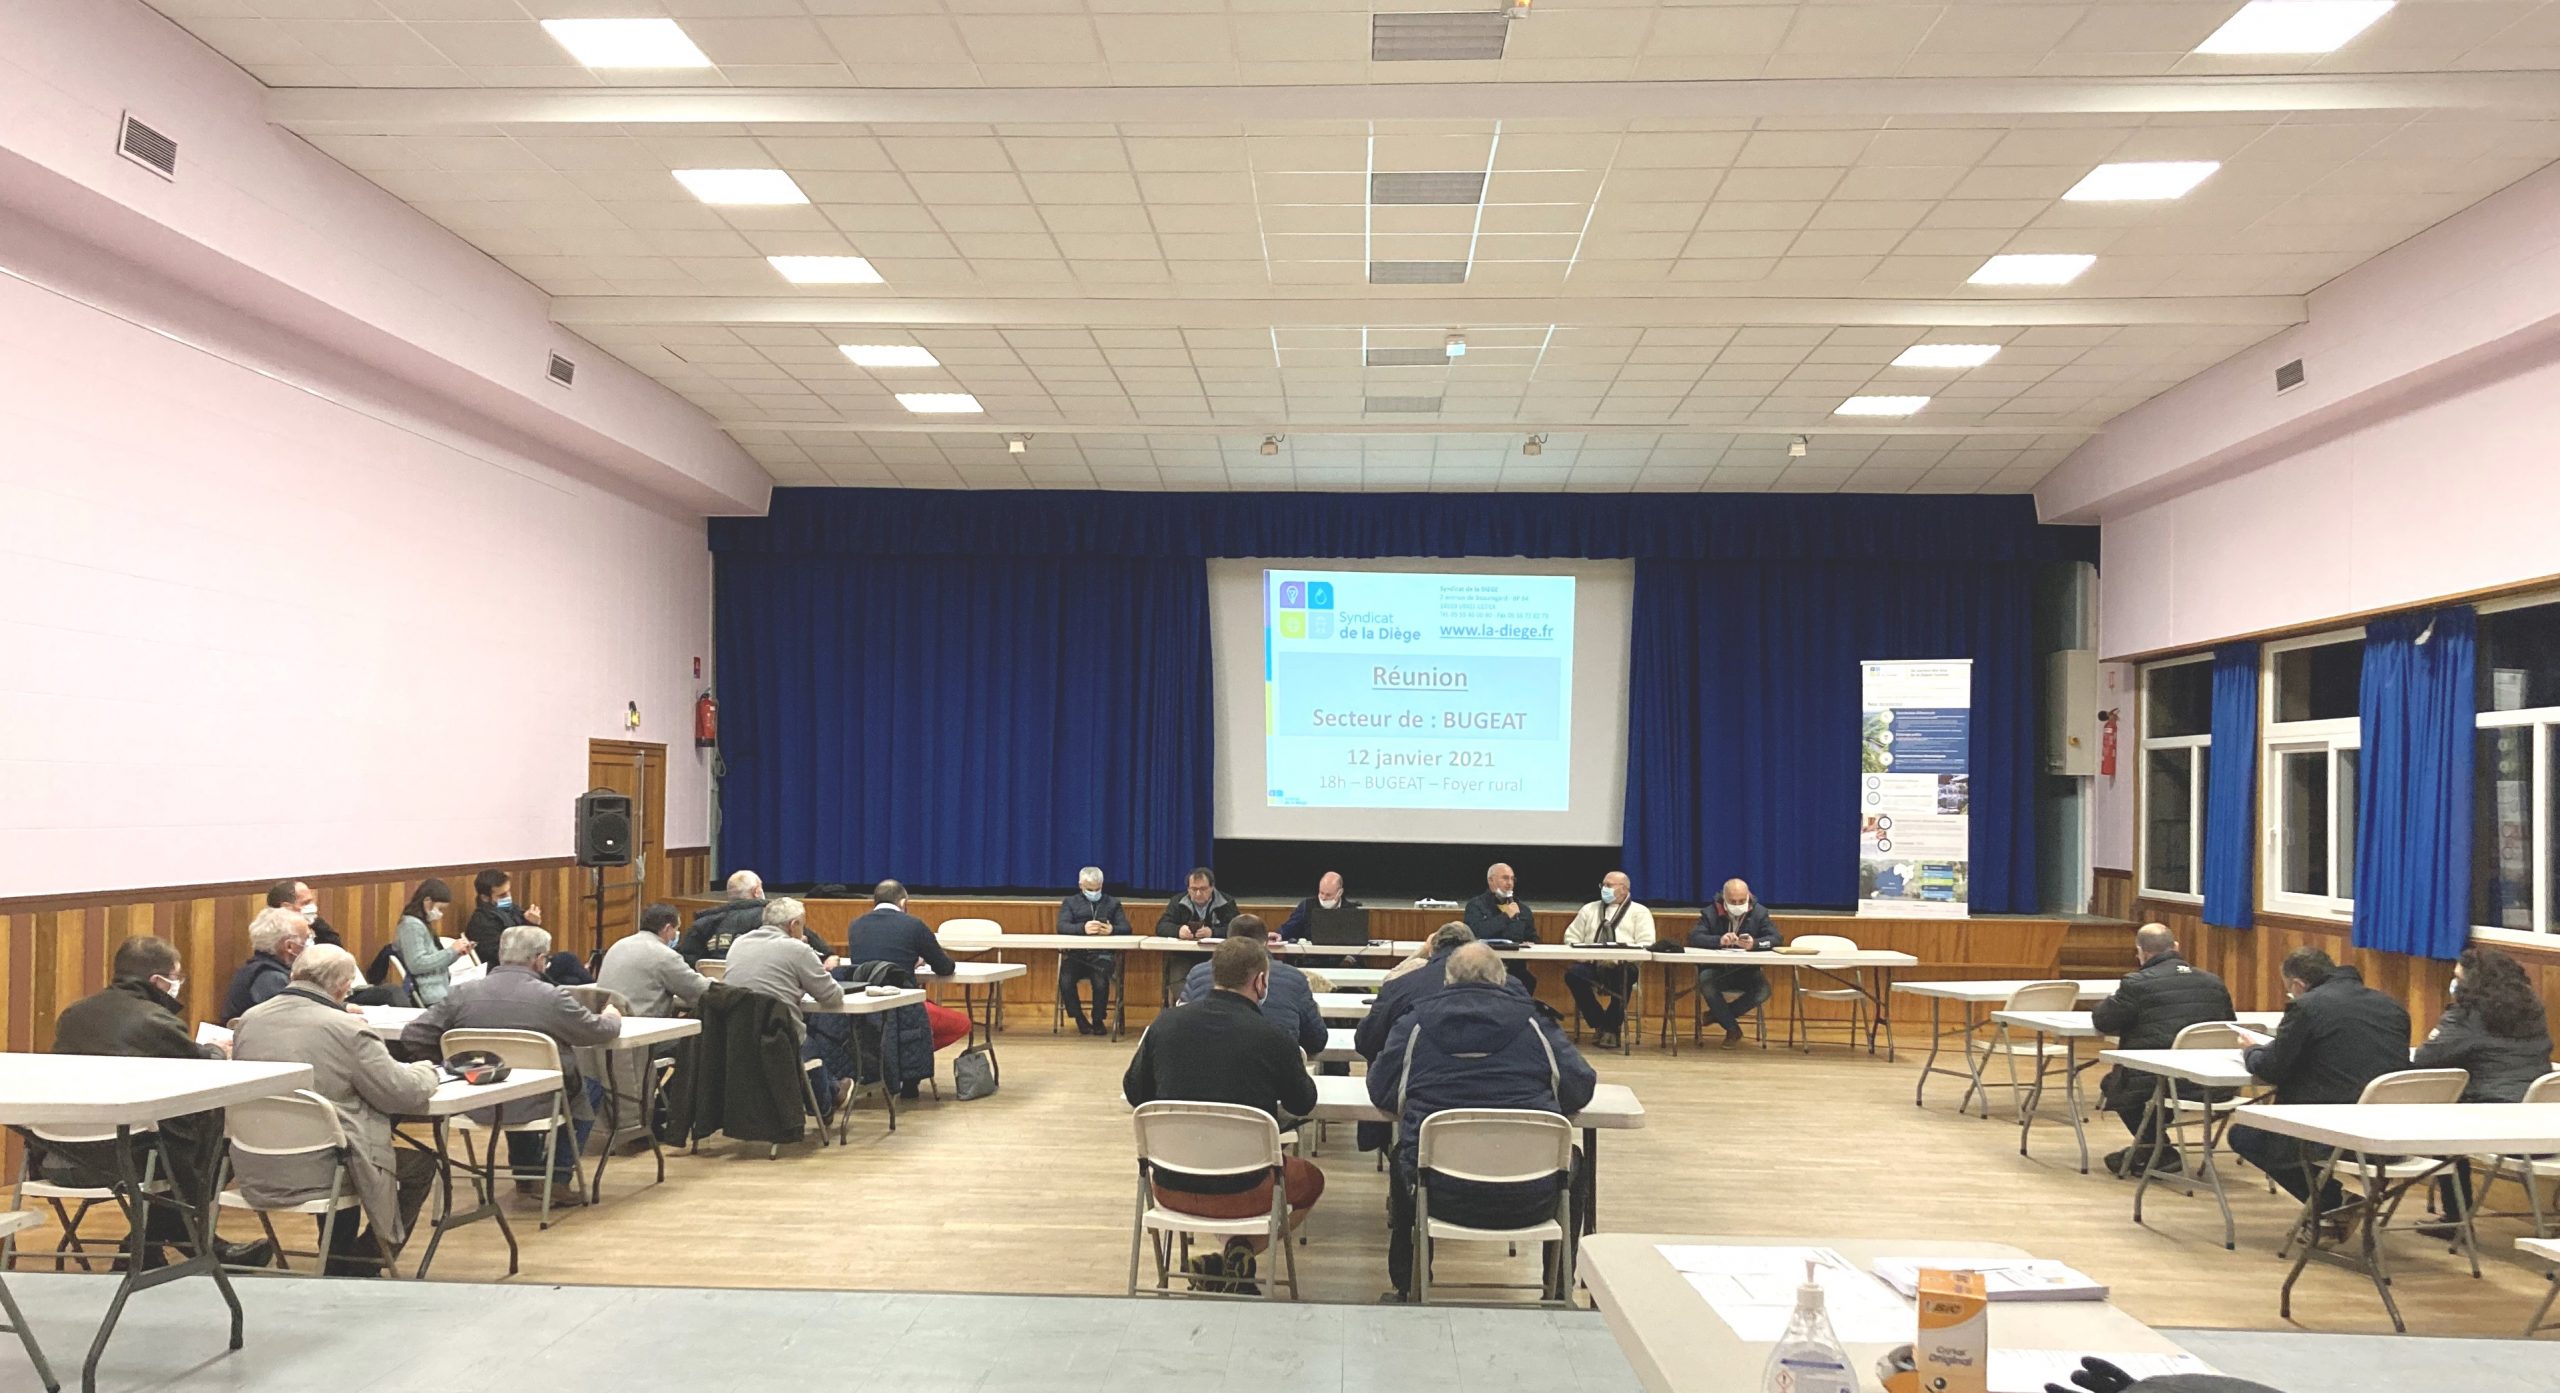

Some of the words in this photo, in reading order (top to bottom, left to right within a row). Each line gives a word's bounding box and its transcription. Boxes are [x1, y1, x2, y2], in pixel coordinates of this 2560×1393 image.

[1340, 612, 1394, 626] Syndicat
[1340, 627, 1358, 639] de
[1362, 627, 1374, 640] la
[1379, 627, 1421, 643] Diège
[1440, 624, 1554, 640] www.la-diege.fr
[1372, 665, 1468, 688] Réunion
[1313, 709, 1392, 728] Secteur
[1398, 710, 1424, 728] de
[1443, 711, 1527, 730] BUGEAT
[1347, 749, 1370, 766] 12
[1375, 748, 1443, 769] janvier
[1448, 750, 1495, 767] 2021
[1320, 775, 1347, 790] 18h
[1365, 776, 1425, 790] BUGEAT
[1443, 777, 1483, 795] Foyer
[1489, 778, 1523, 792] rural
[1928, 1353, 1973, 1367] Original
